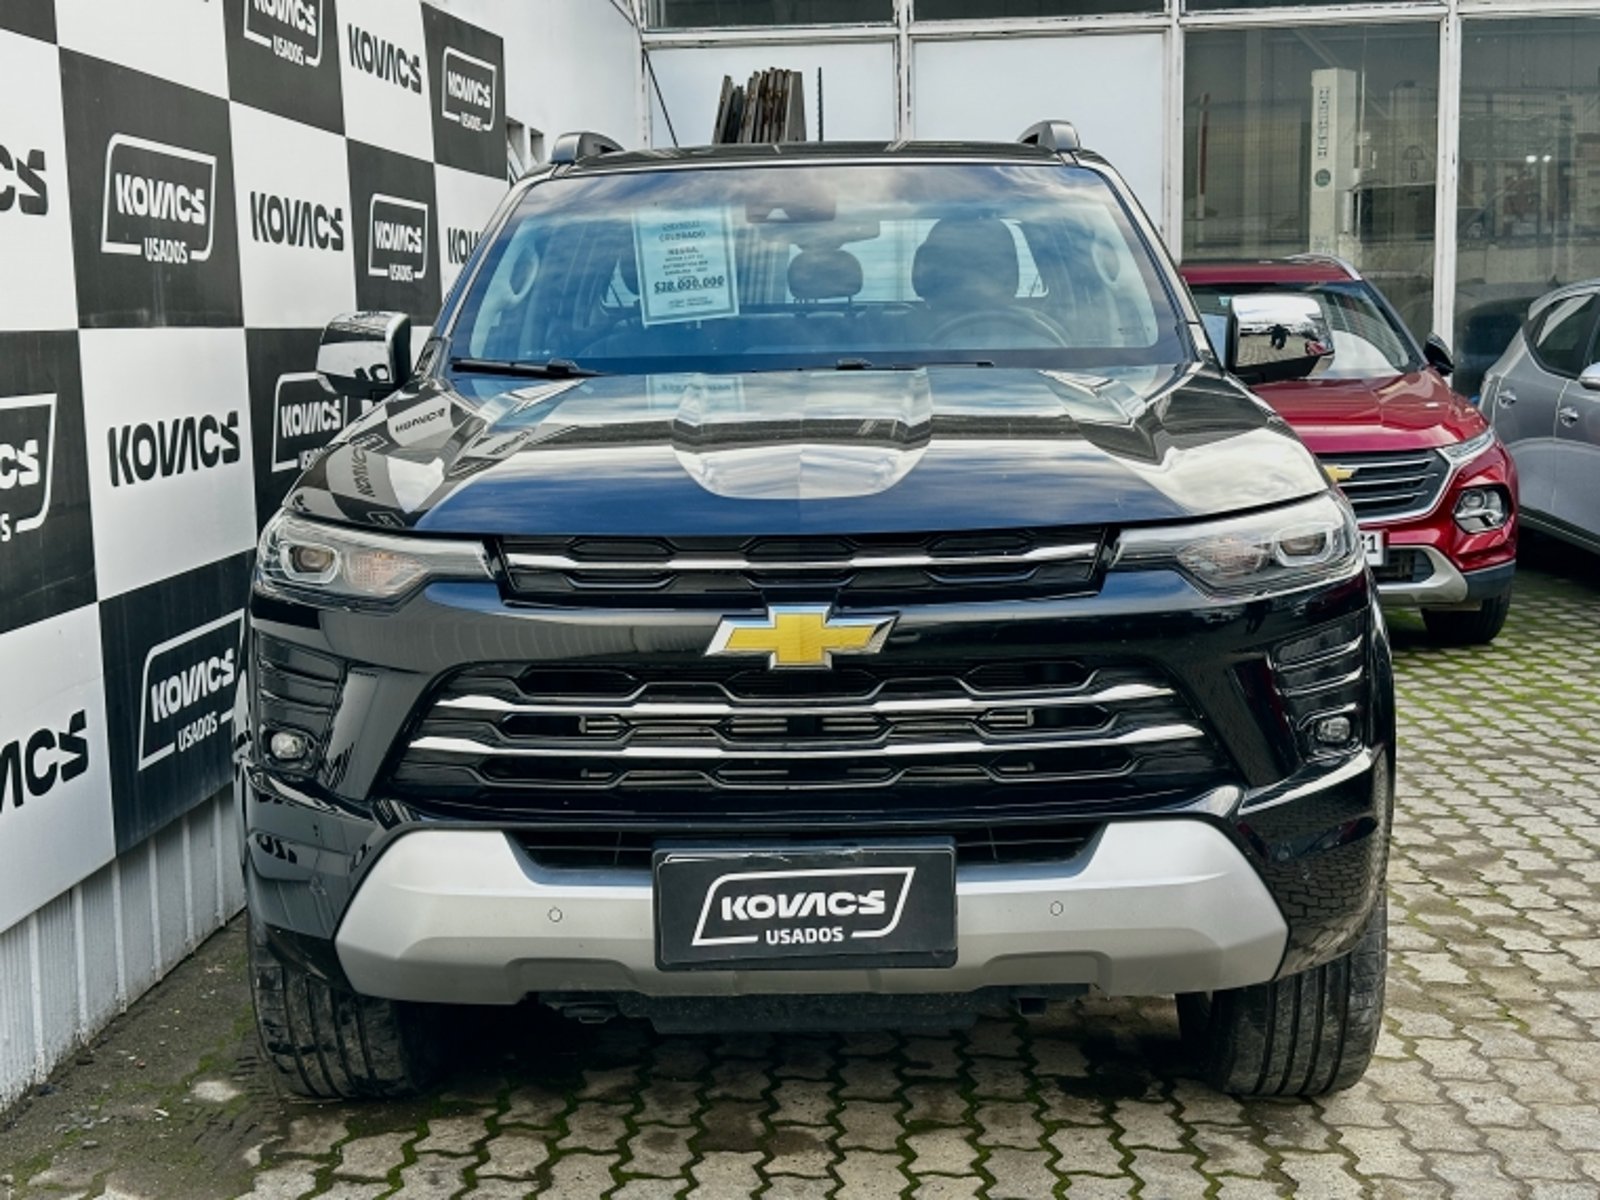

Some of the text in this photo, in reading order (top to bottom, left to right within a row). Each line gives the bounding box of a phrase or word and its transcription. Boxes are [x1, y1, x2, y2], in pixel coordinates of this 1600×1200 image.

[273, 34, 304, 66] USADOS
[348, 23, 421, 94] KOVACS
[448, 71, 491, 108] KOVACS
[115, 172, 206, 225] KOVACS
[251, 192, 344, 251] KOVACS
[375, 221, 422, 253] KOVACS
[145, 238, 187, 264] USADOS
[389, 264, 414, 282] USADOS
[281, 400, 341, 438] KOVACS
[108, 411, 240, 487] KOVACS
[151, 648, 235, 723] KOVACS
[178, 711, 217, 752] USADOS
[721, 890, 886, 921] KOVACS
[766, 927, 843, 945] USADOS
